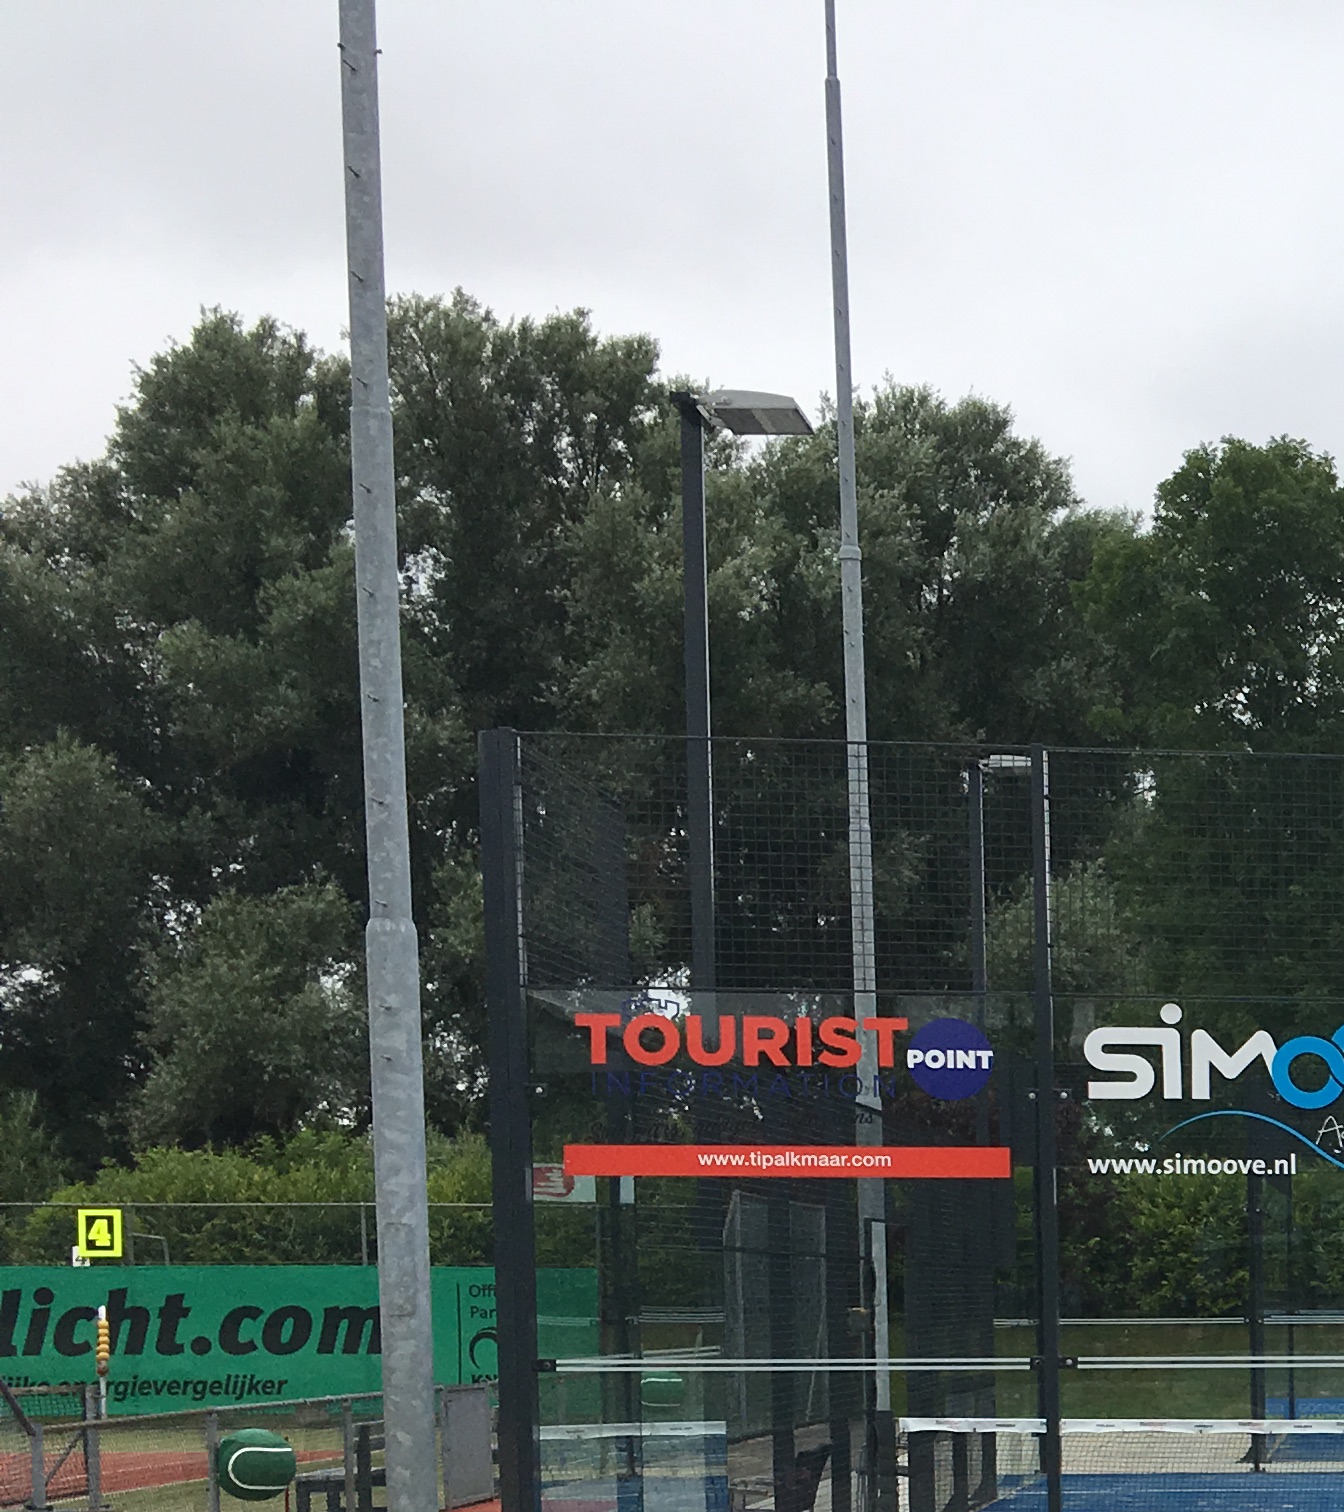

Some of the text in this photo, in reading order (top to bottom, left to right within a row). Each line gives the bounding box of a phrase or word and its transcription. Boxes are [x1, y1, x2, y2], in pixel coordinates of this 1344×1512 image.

[575, 1013, 994, 1070] TOURIST POINT
[591, 1071, 895, 1099] INFORMATION
[698, 1150, 891, 1169] www.tipalkmaar.com
[1087, 1153, 1297, 1175] www.simoove.nl
[88, 1218, 112, 1247] 4
